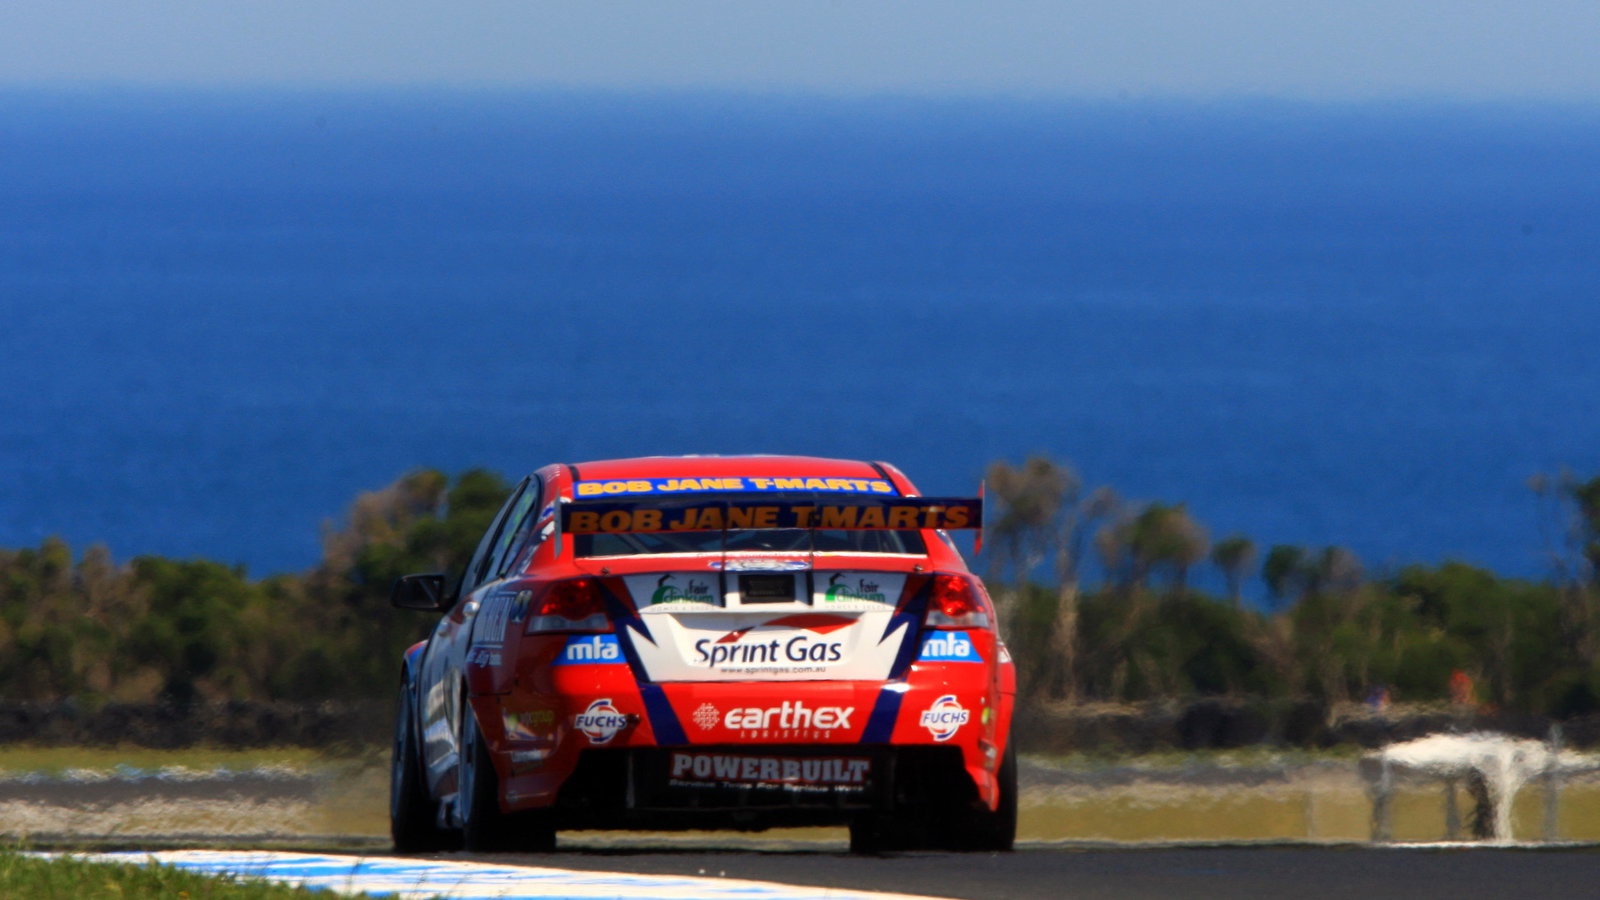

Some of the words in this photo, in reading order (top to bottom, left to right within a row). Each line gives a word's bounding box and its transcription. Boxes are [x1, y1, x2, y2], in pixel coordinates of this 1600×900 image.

[578, 481, 653, 495] BOB
[657, 478, 744, 492] JANE
[569, 509, 663, 532] BOB
[669, 507, 777, 530] JANE
[688, 579, 709, 594] fair
[859, 578, 879, 592] fair
[694, 639, 780, 668] Sprint
[785, 636, 842, 662] Gas
[720, 666, 827, 675] www.sprintgas.com.au
[576, 715, 626, 728] FUCHS
[724, 701, 855, 729] earthex
[922, 712, 968, 724] FUCHS
[740, 729, 831, 739] LOGISTICS
[672, 753, 869, 781] POWERBUILT
